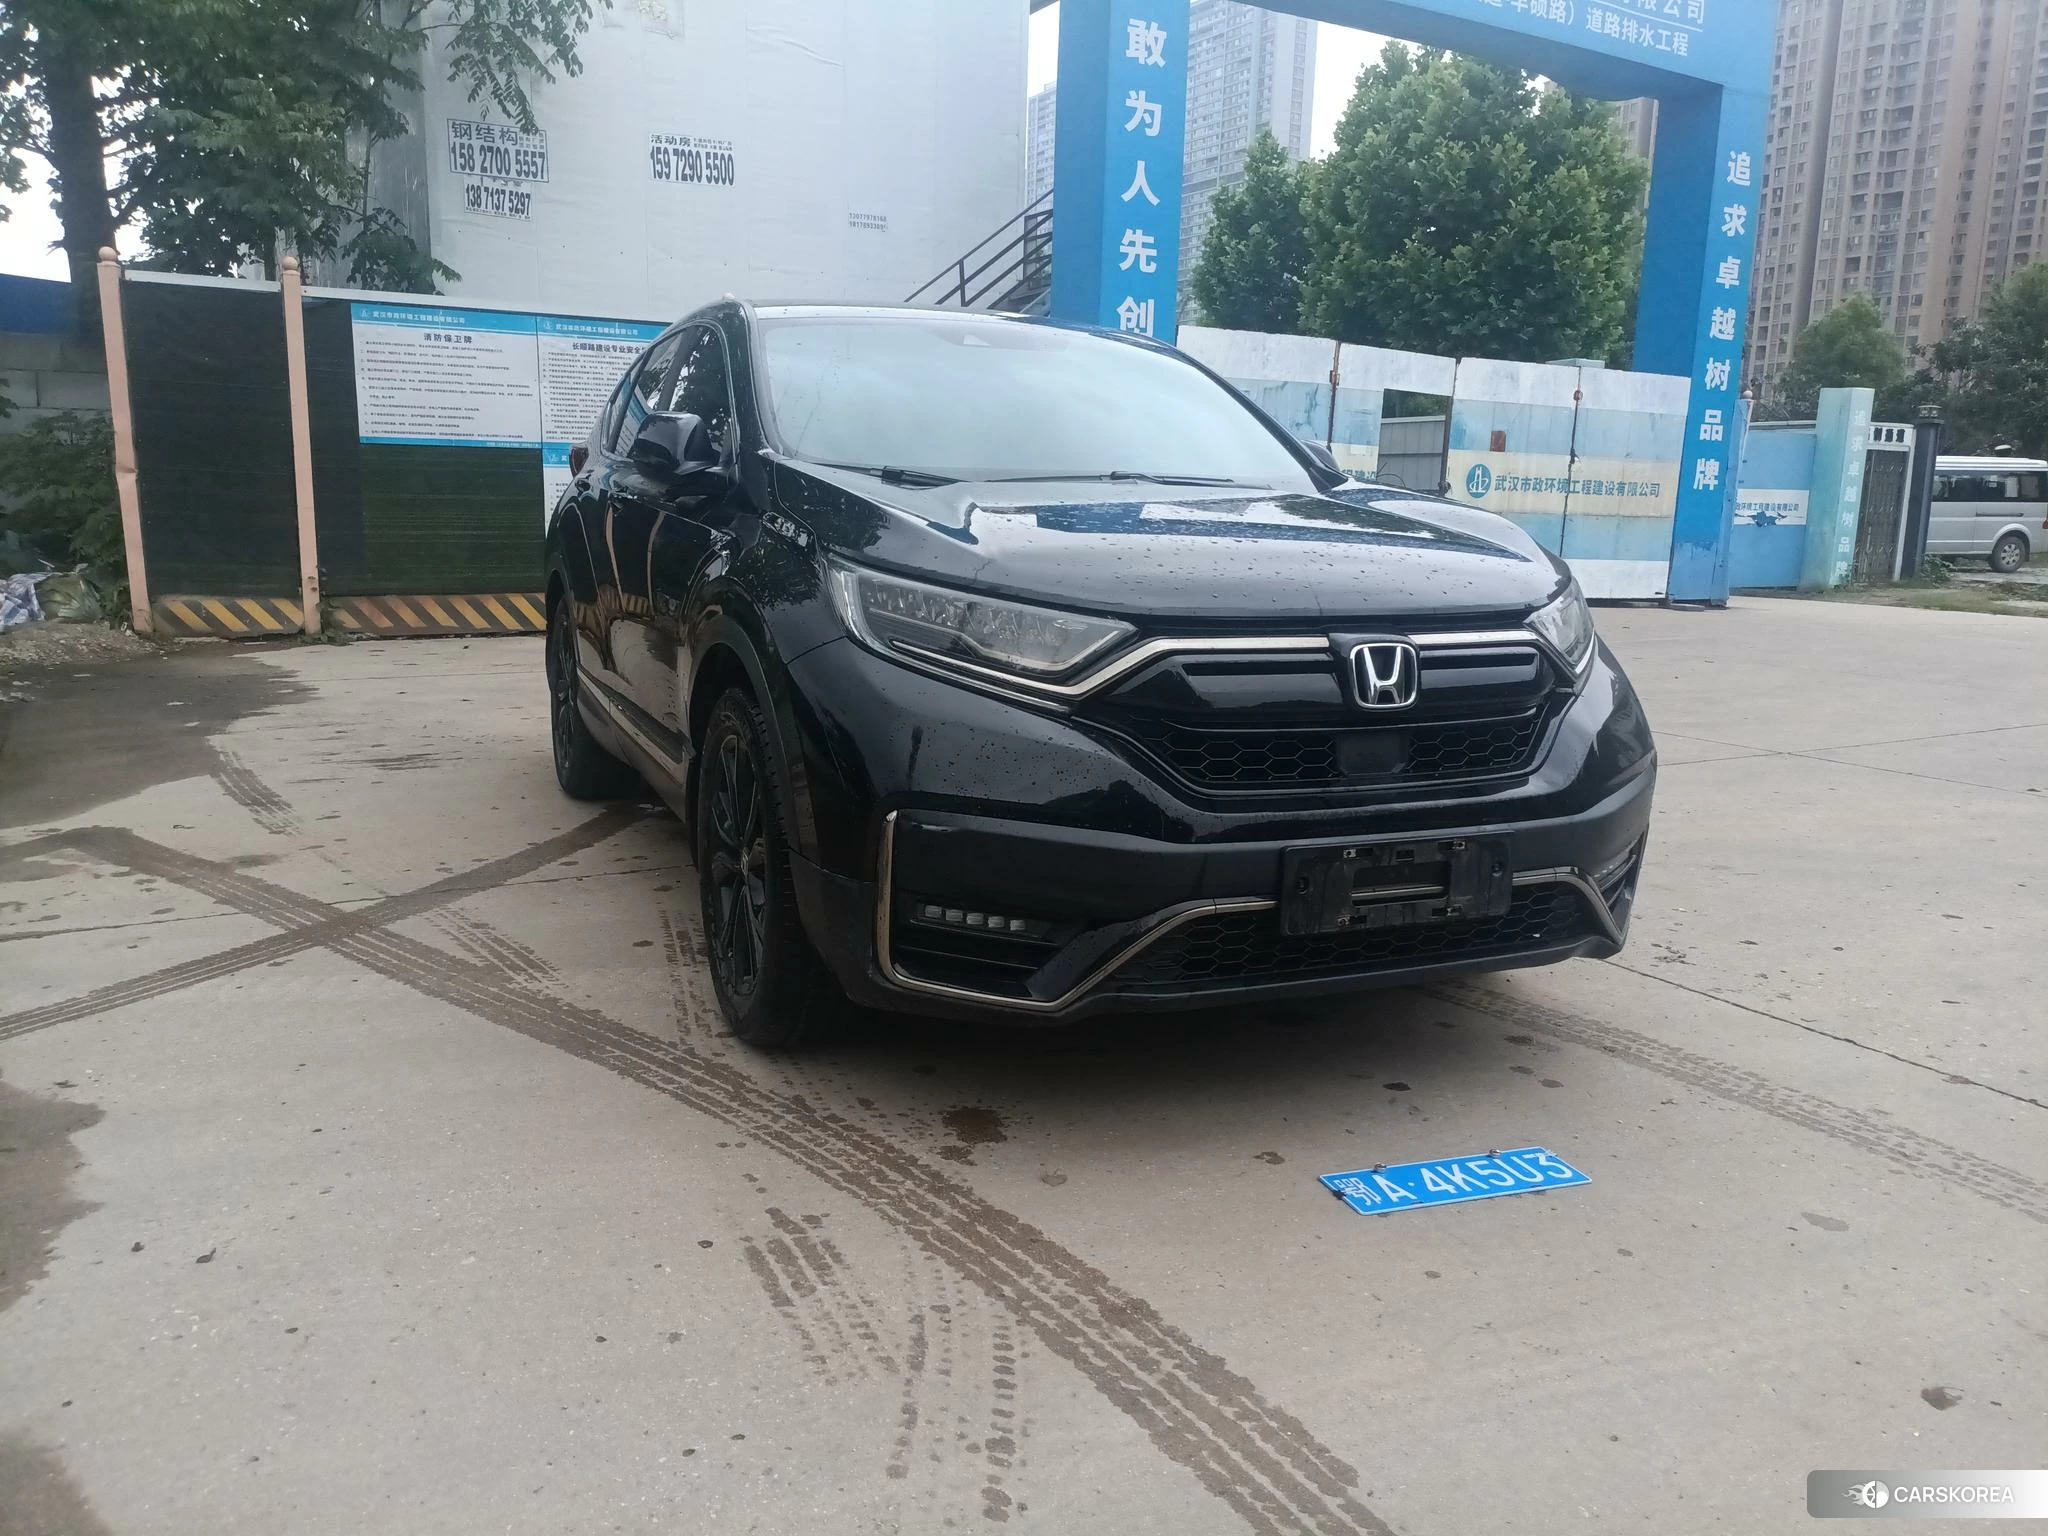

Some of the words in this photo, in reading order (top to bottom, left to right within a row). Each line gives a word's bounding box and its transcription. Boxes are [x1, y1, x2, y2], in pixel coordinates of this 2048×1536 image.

[451, 121, 518, 146] 钢结构
[651, 134, 690, 147] 活动房
[451, 141, 475, 172] 158
[479, 144, 511, 176] 2700
[515, 149, 545, 179] 5557
[650, 146, 671, 180] 159
[673, 148, 702, 183] 7290
[705, 151, 734, 186] 5500
[1117, 18, 1167, 338] 敢为人先创
[466, 183, 482, 208] 138
[484, 186, 506, 212] 7137
[508, 190, 531, 216] 5297
[1693, 151, 1750, 490] 追求卓越树品牌
[423, 332, 473, 344] 消防保卫牌
[1494, 475, 1661, 498] 武汉市政环境工程建设有限公司
